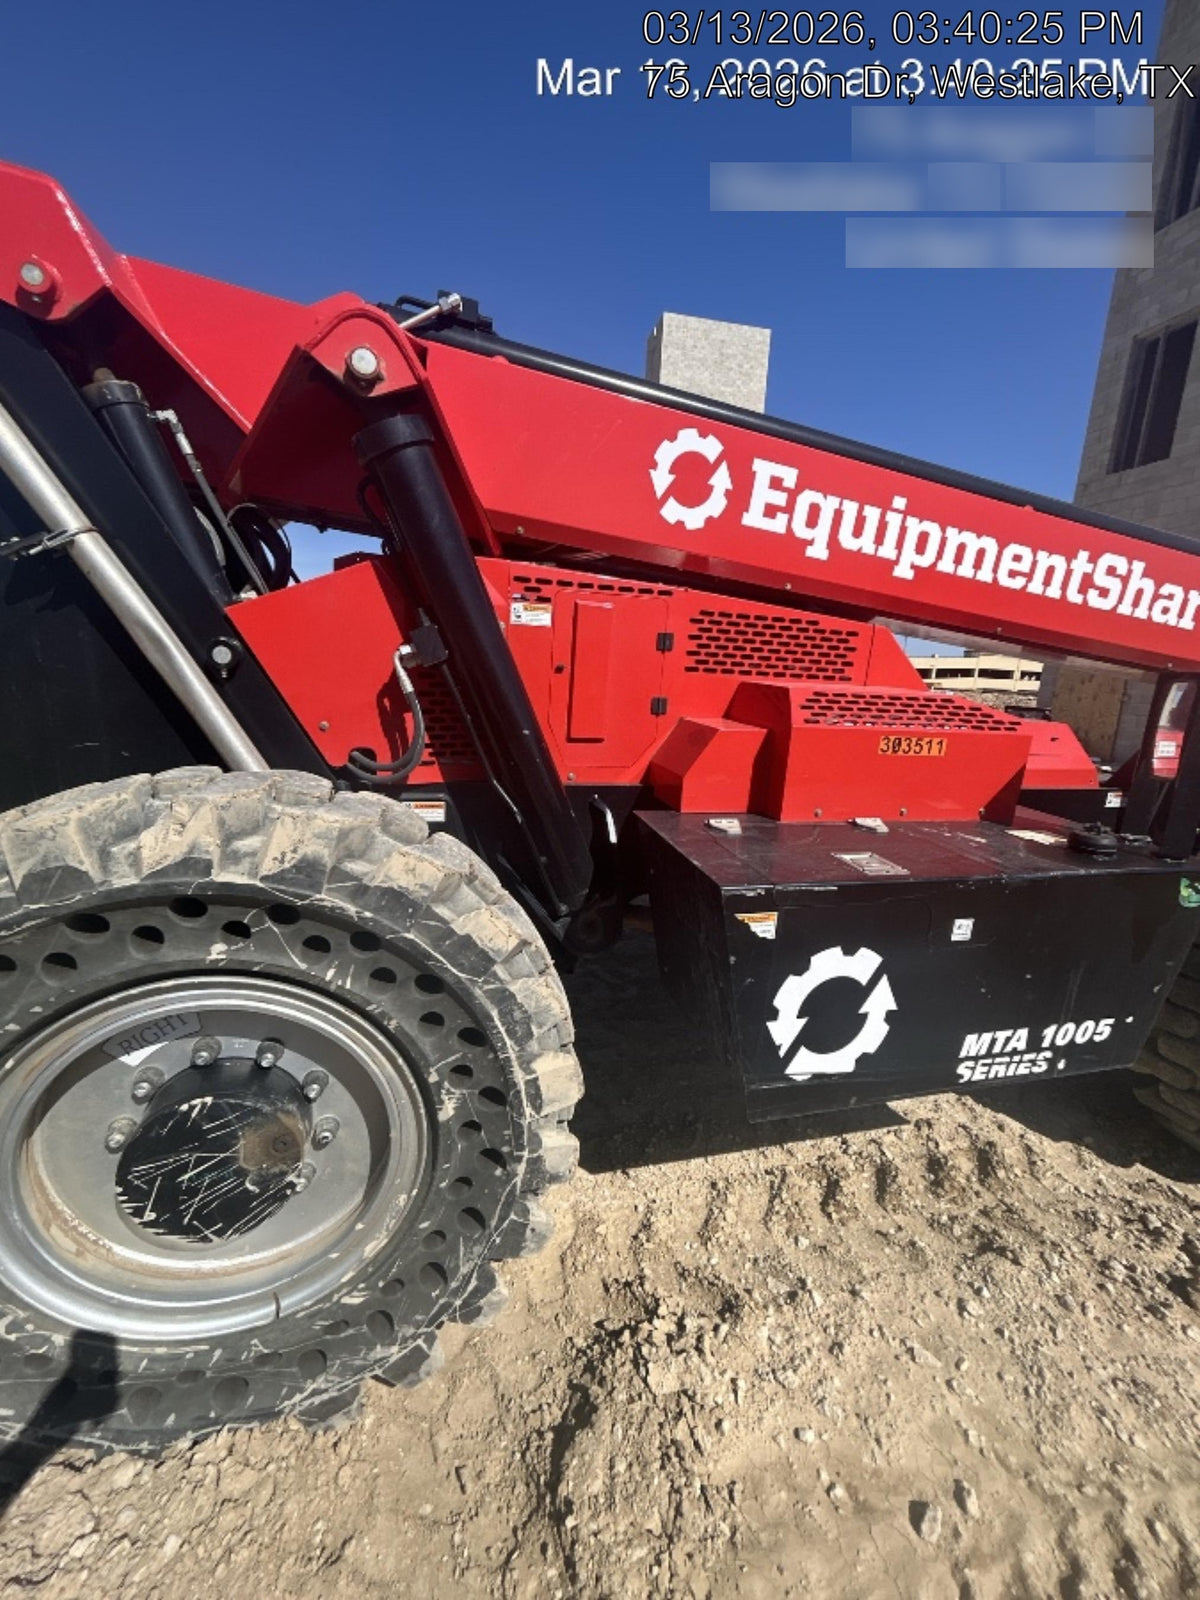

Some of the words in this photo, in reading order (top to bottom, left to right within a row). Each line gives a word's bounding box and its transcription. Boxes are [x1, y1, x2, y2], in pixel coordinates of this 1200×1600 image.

[880, 736, 945, 755] 303511
[958, 1027, 1030, 1059] MTA
[1040, 1017, 1116, 1049] 1005
[956, 1050, 1054, 1084] SERIES
